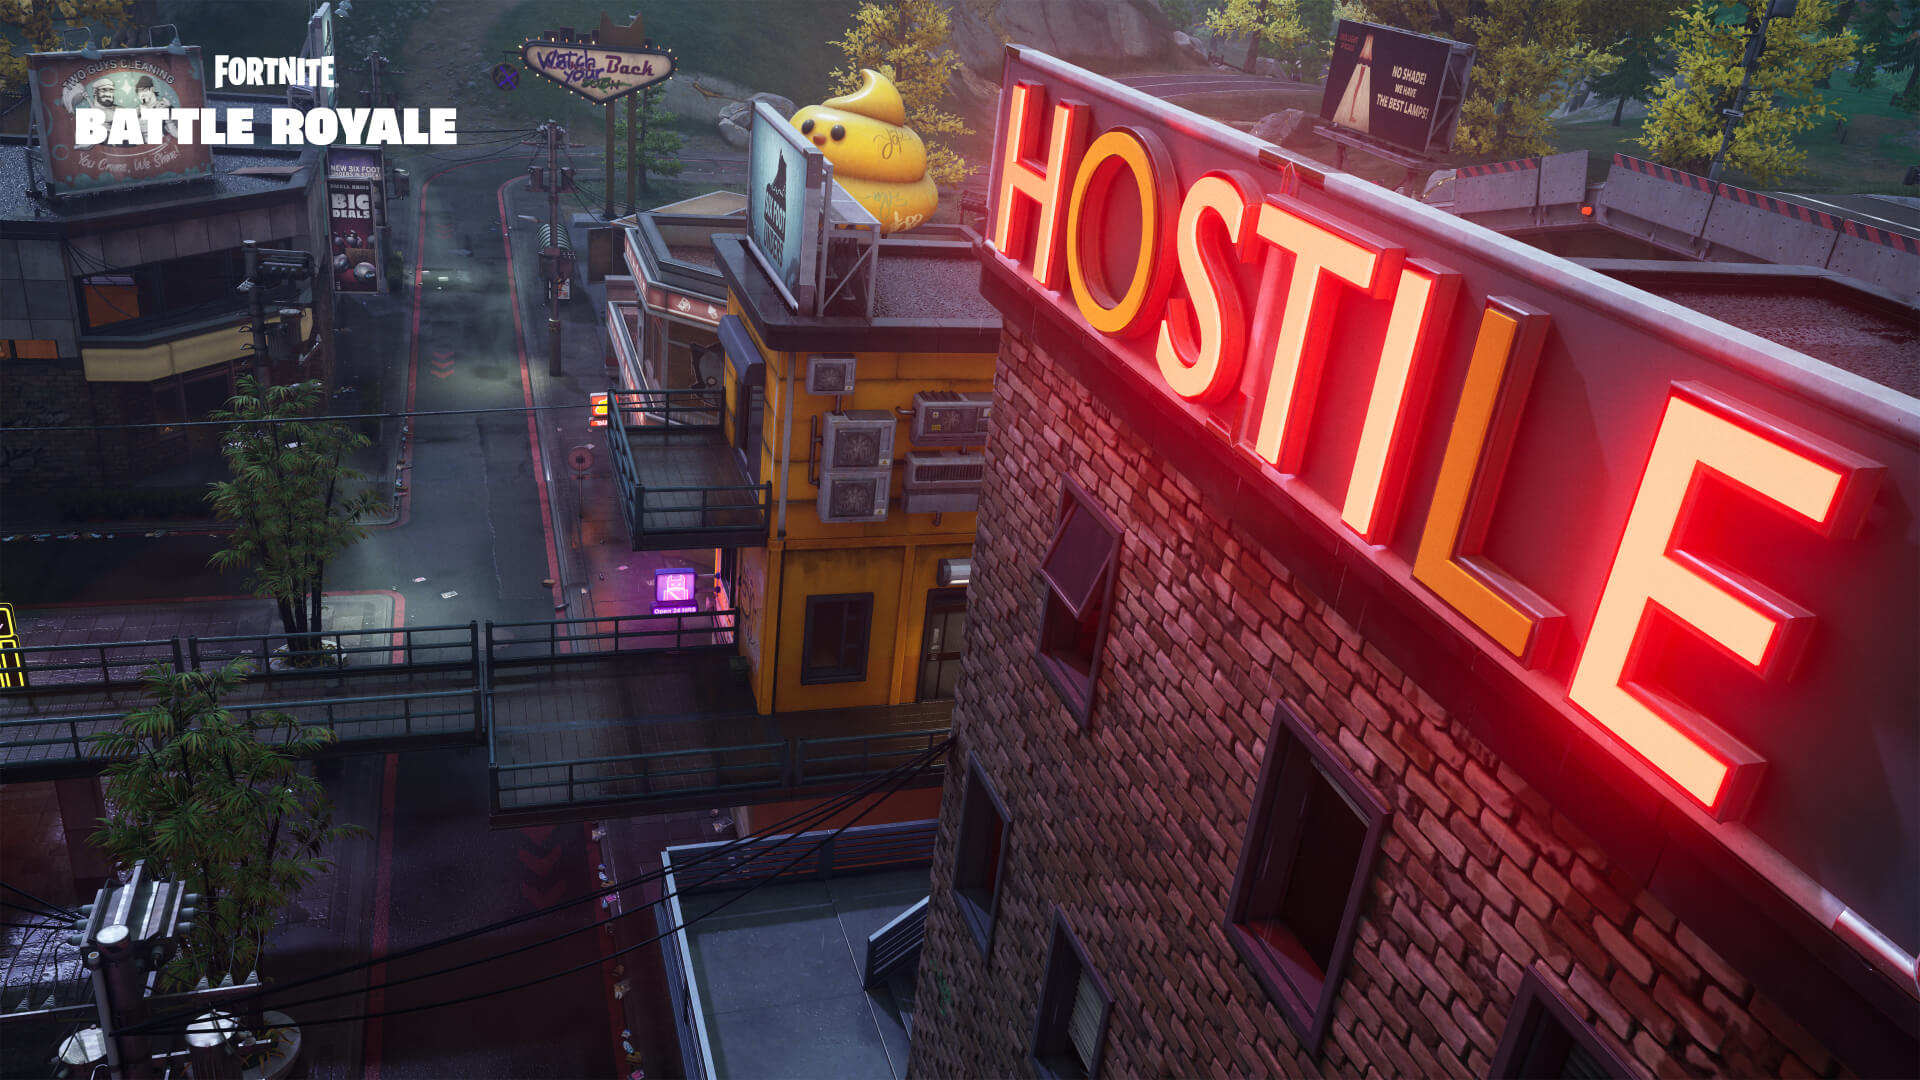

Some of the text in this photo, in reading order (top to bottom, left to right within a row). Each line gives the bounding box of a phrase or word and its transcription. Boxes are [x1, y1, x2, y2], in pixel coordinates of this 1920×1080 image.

[537, 49, 654, 76] Watch Back
[63, 60, 174, 91] TWO GUYS CLEANING
[563, 66, 605, 83] your
[1391, 65, 1427, 85] NO SHADE!
[1394, 84, 1417, 98] WE HAVE
[1376, 93, 1430, 120] THE BEST LAMPS!
[80, 152, 95, 168] You
[134, 158, 151, 171] We
[331, 193, 370, 209] BIG
[332, 210, 370, 219] DEALS
[773, 198, 786, 234] FOOT
[764, 221, 784, 268] UNDERS
[990, 81, 1885, 822] HOSTILE
[654, 607, 672, 615] Open
